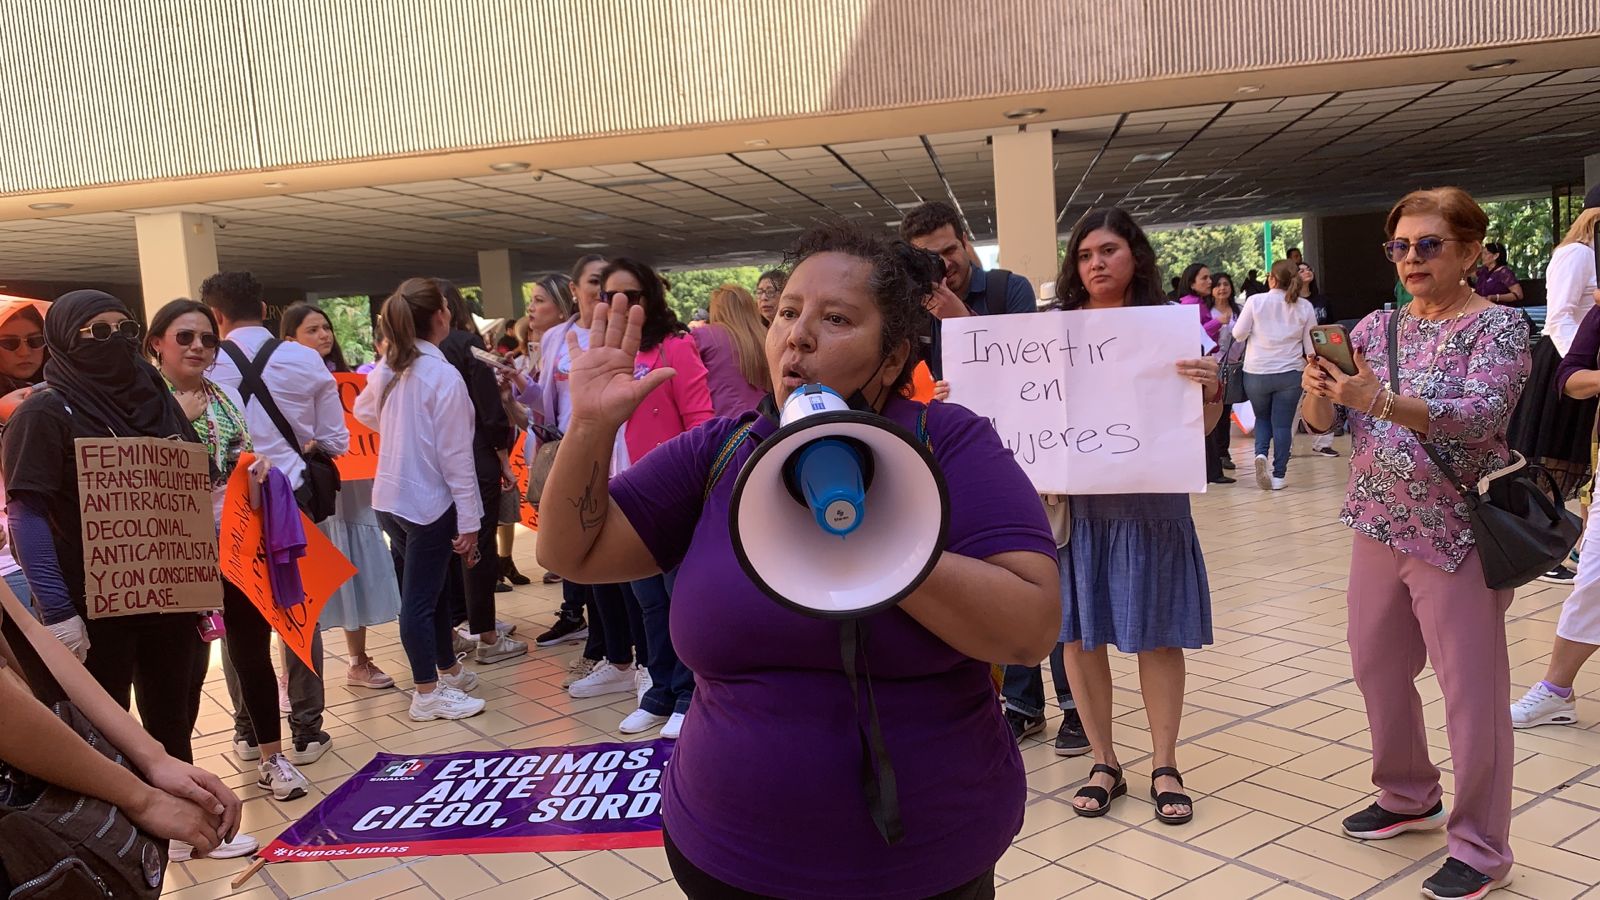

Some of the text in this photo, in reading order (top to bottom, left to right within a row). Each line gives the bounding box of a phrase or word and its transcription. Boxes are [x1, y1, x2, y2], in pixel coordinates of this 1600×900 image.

[962, 329, 1118, 367] Invertir
[1020, 379, 1062, 402] en
[988, 417, 1140, 465] ujeres
[81, 444, 190, 469] FEMINISMO
[83, 491, 200, 514] ANTIRRACISTA,
[91, 541, 219, 567] ANTICAPITALISTA,
[90, 570, 107, 594] Y
[112, 569, 145, 589] CON
[150, 566, 219, 585] CONSCIENCIA
[95, 588, 179, 614] DE CLASE.
[433, 748, 654, 780] EXIGIMOS
[414, 769, 662, 803] ANTE UN G
[352, 792, 662, 831] CIEGO, SORD
[273, 846, 409, 857] #VamosJuntas
